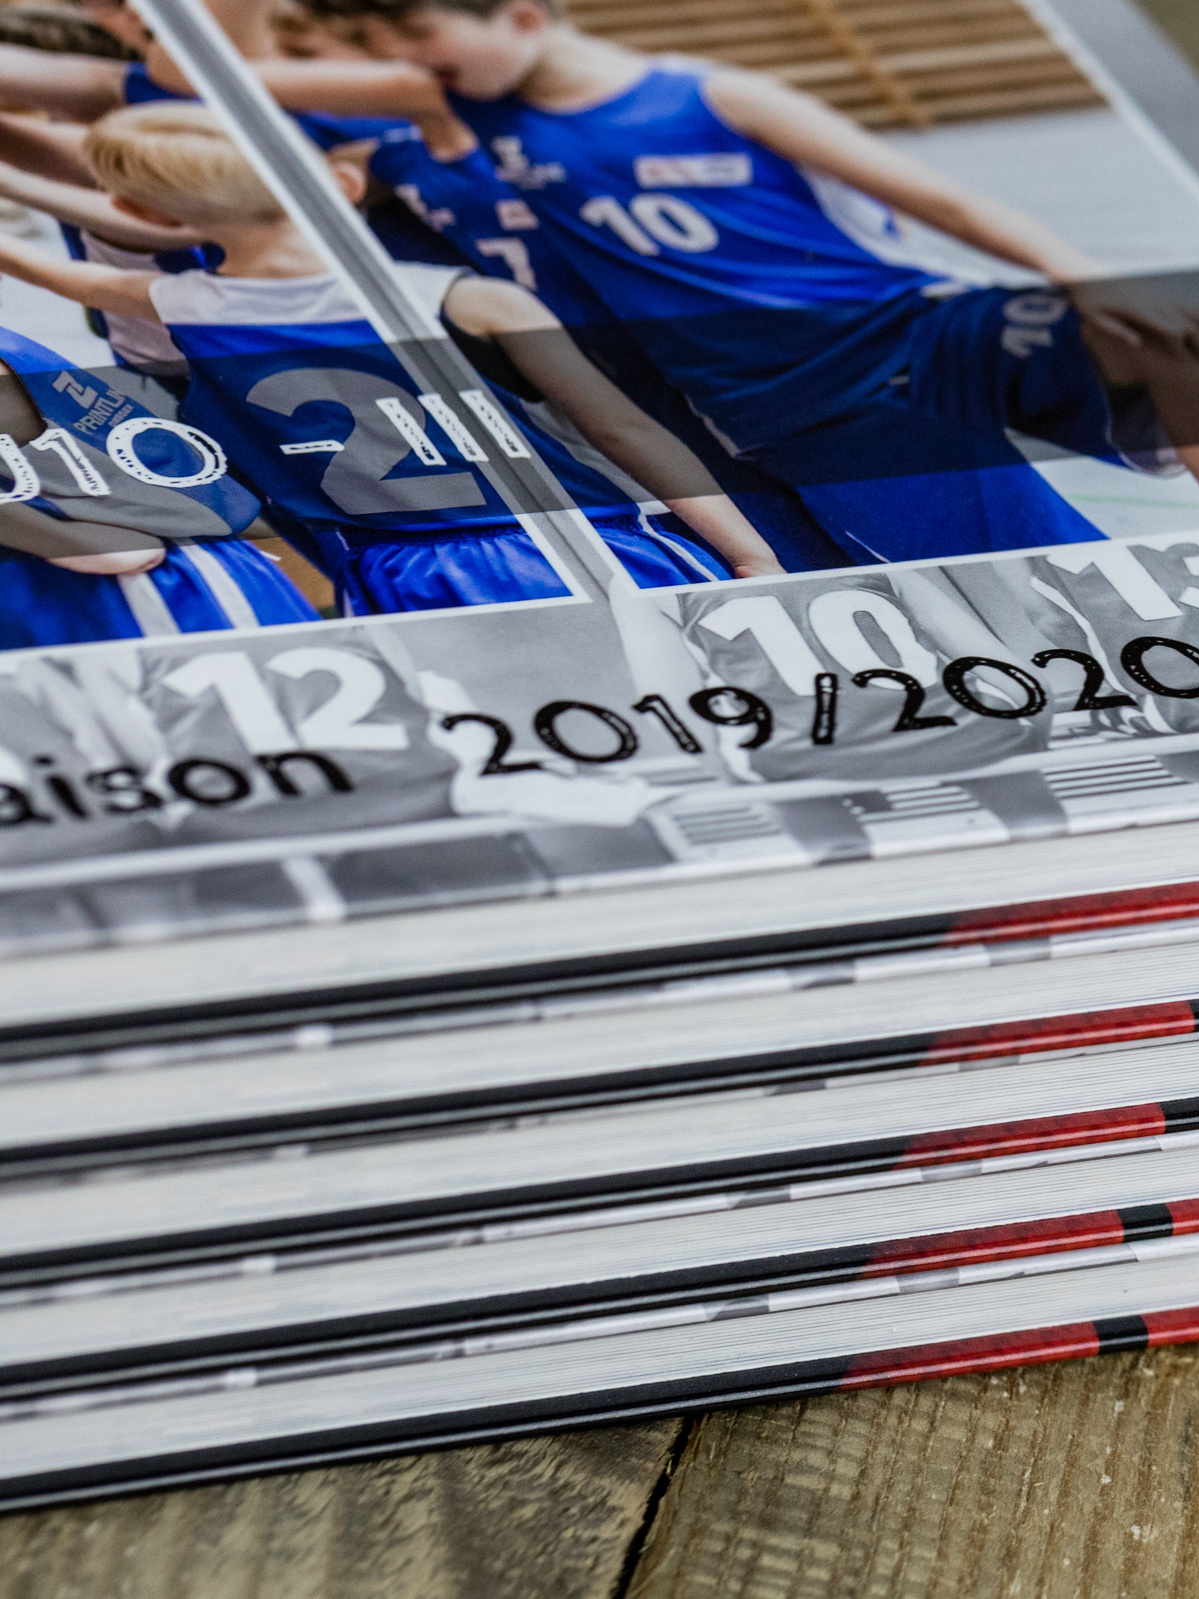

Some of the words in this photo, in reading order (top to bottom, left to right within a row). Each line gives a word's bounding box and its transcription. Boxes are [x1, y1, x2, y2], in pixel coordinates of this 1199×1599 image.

[580, 191, 719, 256] 10
[1001, 295, 1066, 359] 10
[246, 367, 487, 515] 2
[699, 589, 938, 696] 10
[164, 646, 409, 755] 12
